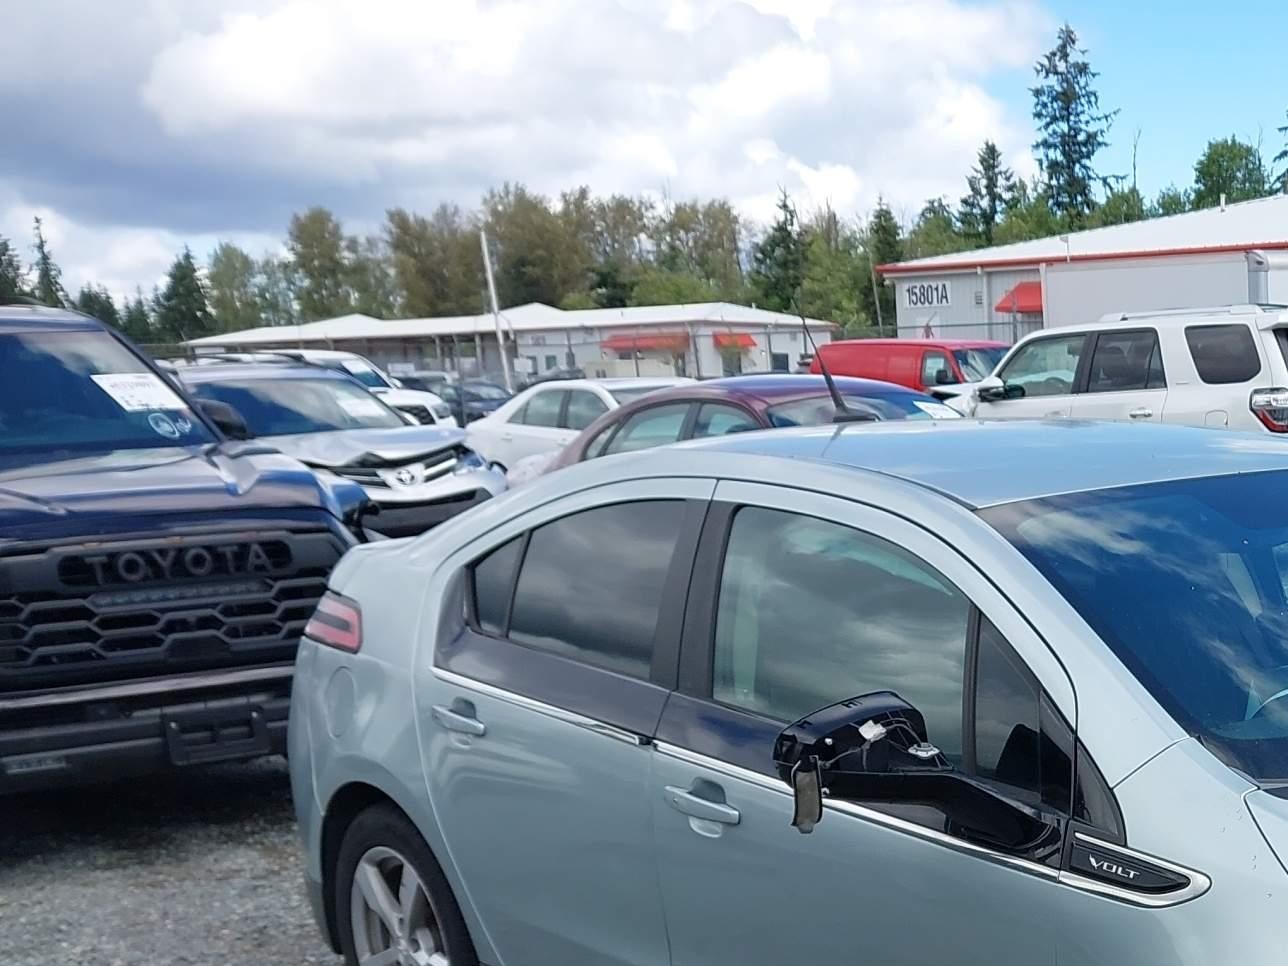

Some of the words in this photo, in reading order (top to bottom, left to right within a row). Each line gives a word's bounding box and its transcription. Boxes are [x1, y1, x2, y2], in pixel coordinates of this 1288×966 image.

[906, 283, 949, 306] 15801A
[84, 543, 273, 585] TOYOTA
[1089, 853, 1140, 879] VOLT
